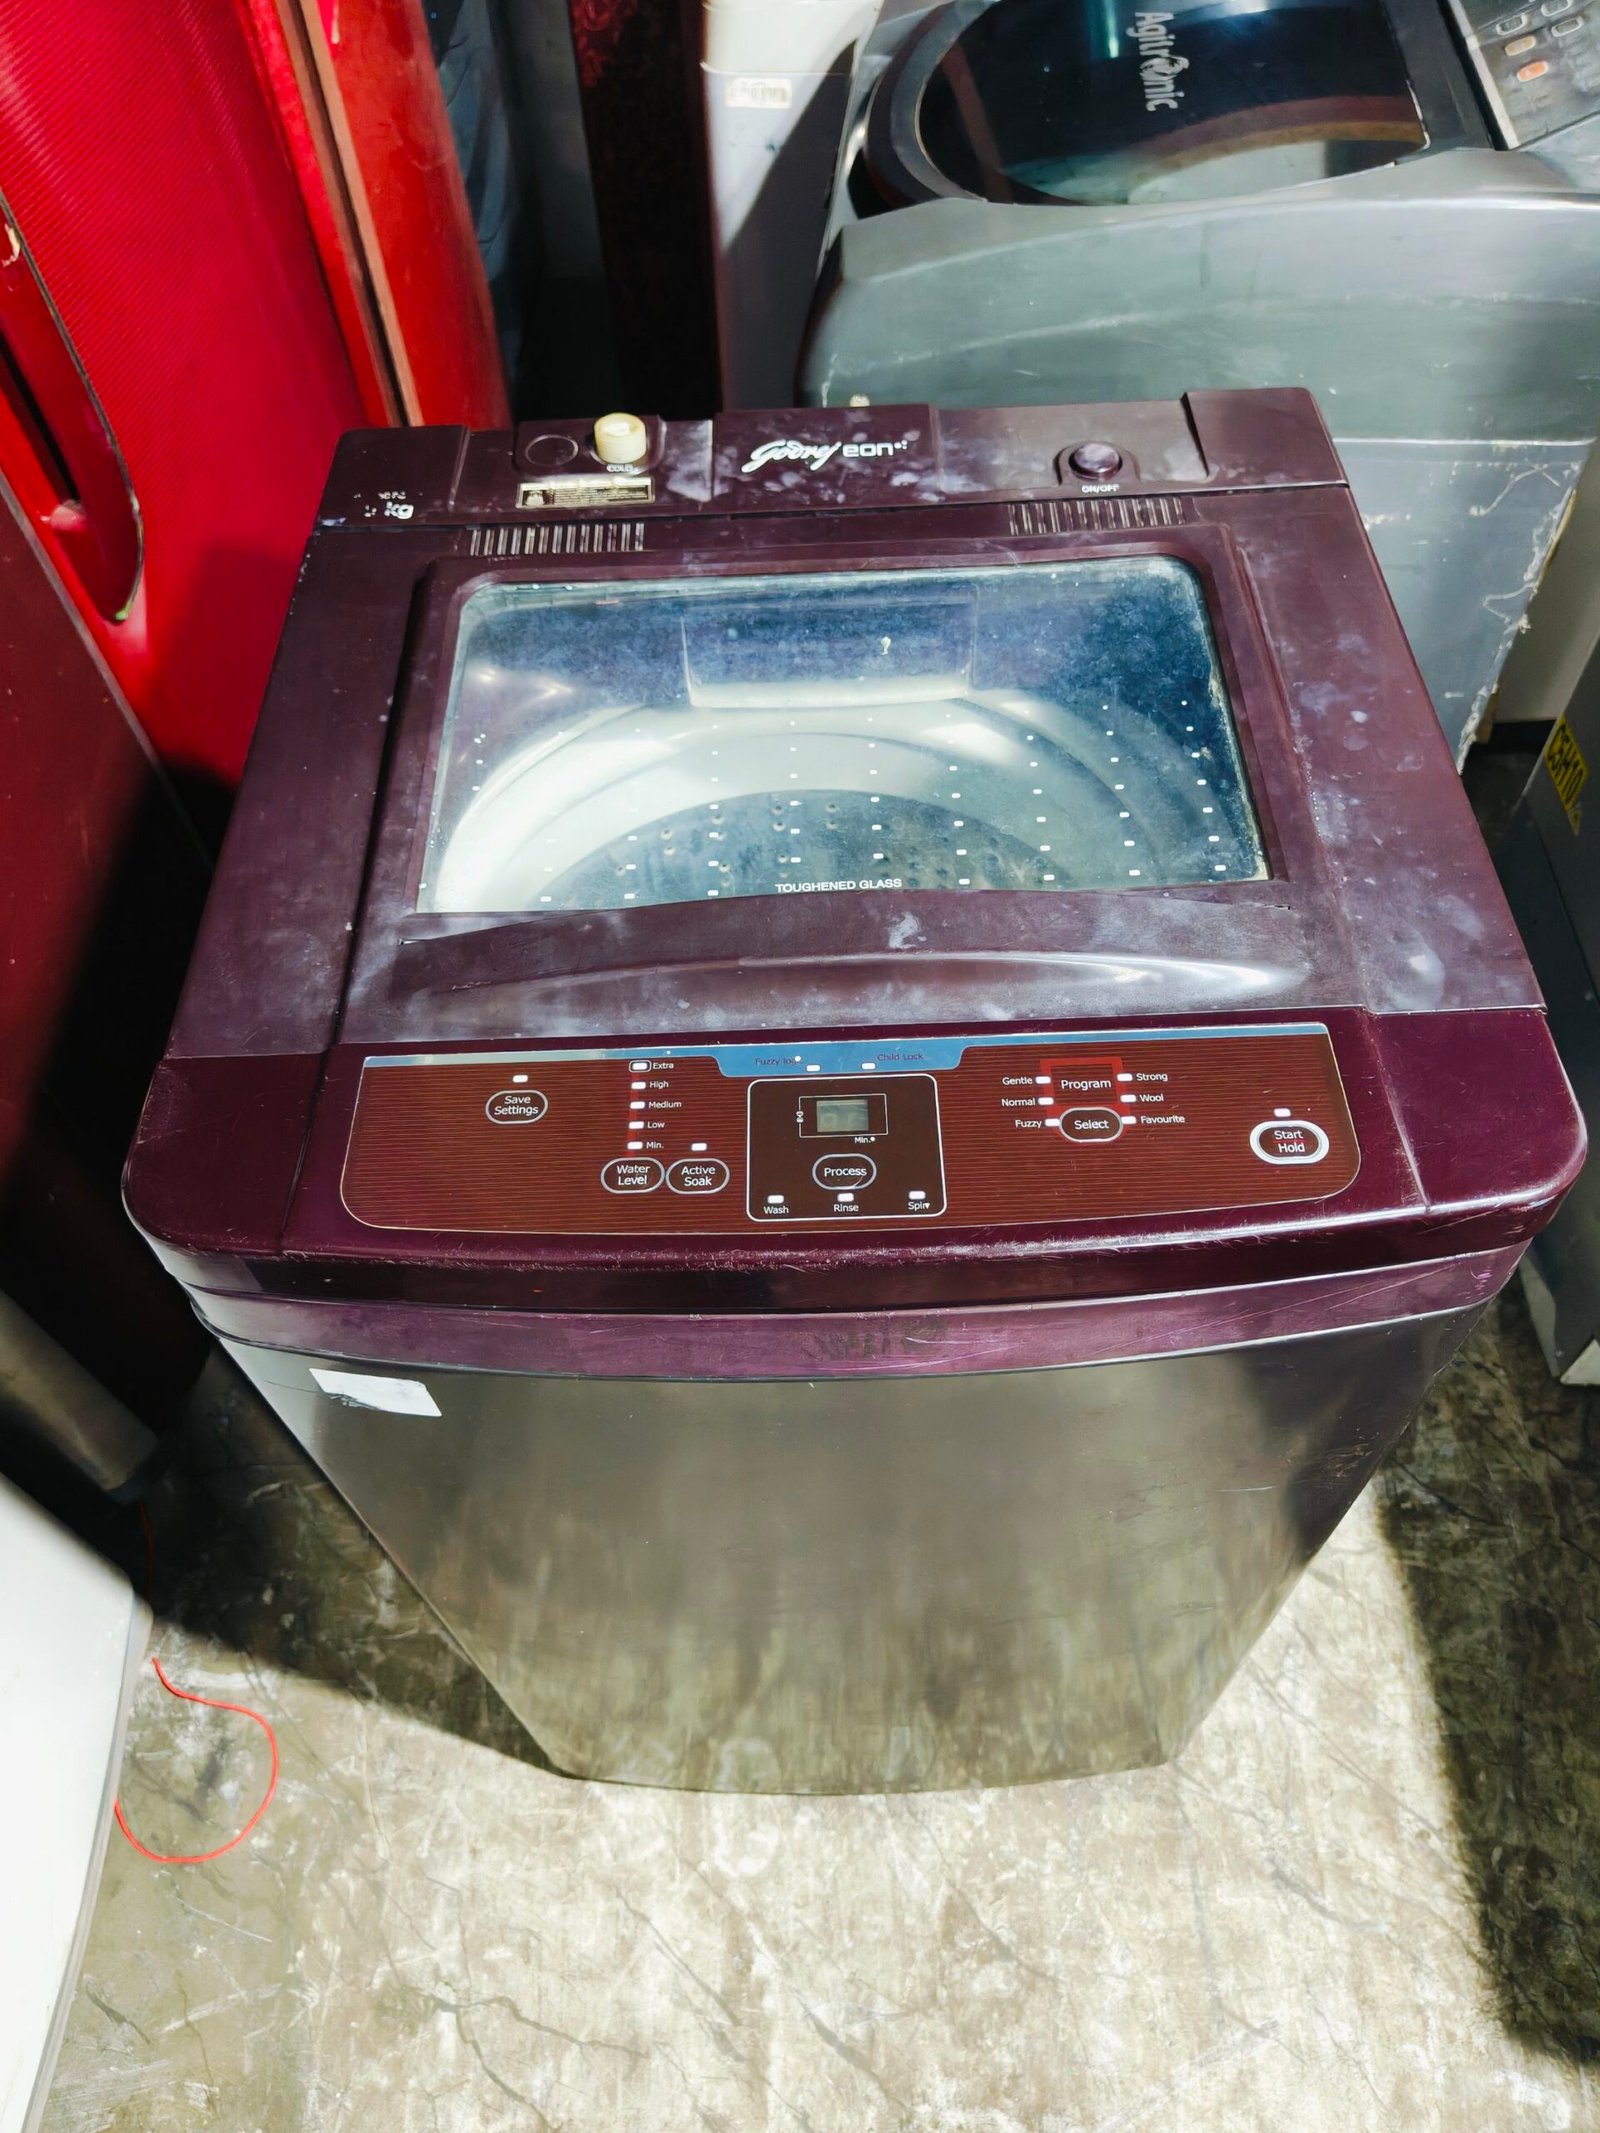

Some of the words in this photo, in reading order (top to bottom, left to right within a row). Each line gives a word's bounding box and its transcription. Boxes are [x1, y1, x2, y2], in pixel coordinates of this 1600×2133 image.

[1081, 483, 1120, 494] ON/OFF
[775, 880, 857, 893] TOUGHENED
[859, 878, 903, 889] GLASS
[877, 1053, 900, 1061] Child
[903, 1052, 924, 1061] Lock
[652, 1061, 674, 1070] Extra
[755, 1058, 780, 1066] Fuzzy
[1002, 1076, 1033, 1086] Gentle
[1136, 1072, 1168, 1083] Strong
[649, 1080, 669, 1089] High
[1061, 1079, 1112, 1091] Program
[504, 1095, 531, 1105] Save
[1001, 1097, 1036, 1107] Normal
[1139, 1093, 1164, 1103] Wool
[648, 1099, 682, 1109] Medium
[494, 1105, 539, 1117] Settings
[647, 1120, 665, 1129] Low
[1014, 1119, 1042, 1130] Fuzzy
[1074, 1119, 1109, 1131] Select
[1140, 1115, 1186, 1125] Favourite
[1273, 1130, 1304, 1140] Start
[646, 1140, 665, 1150] Min.
[1278, 1142, 1306, 1153] Hold
[616, 1164, 650, 1175] Water
[681, 1164, 716, 1176] Active
[823, 1167, 868, 1178] Process
[617, 1174, 648, 1186] Level
[684, 1176, 713, 1187] Soak
[763, 1205, 789, 1215] Wash
[833, 1203, 860, 1213] Rinse
